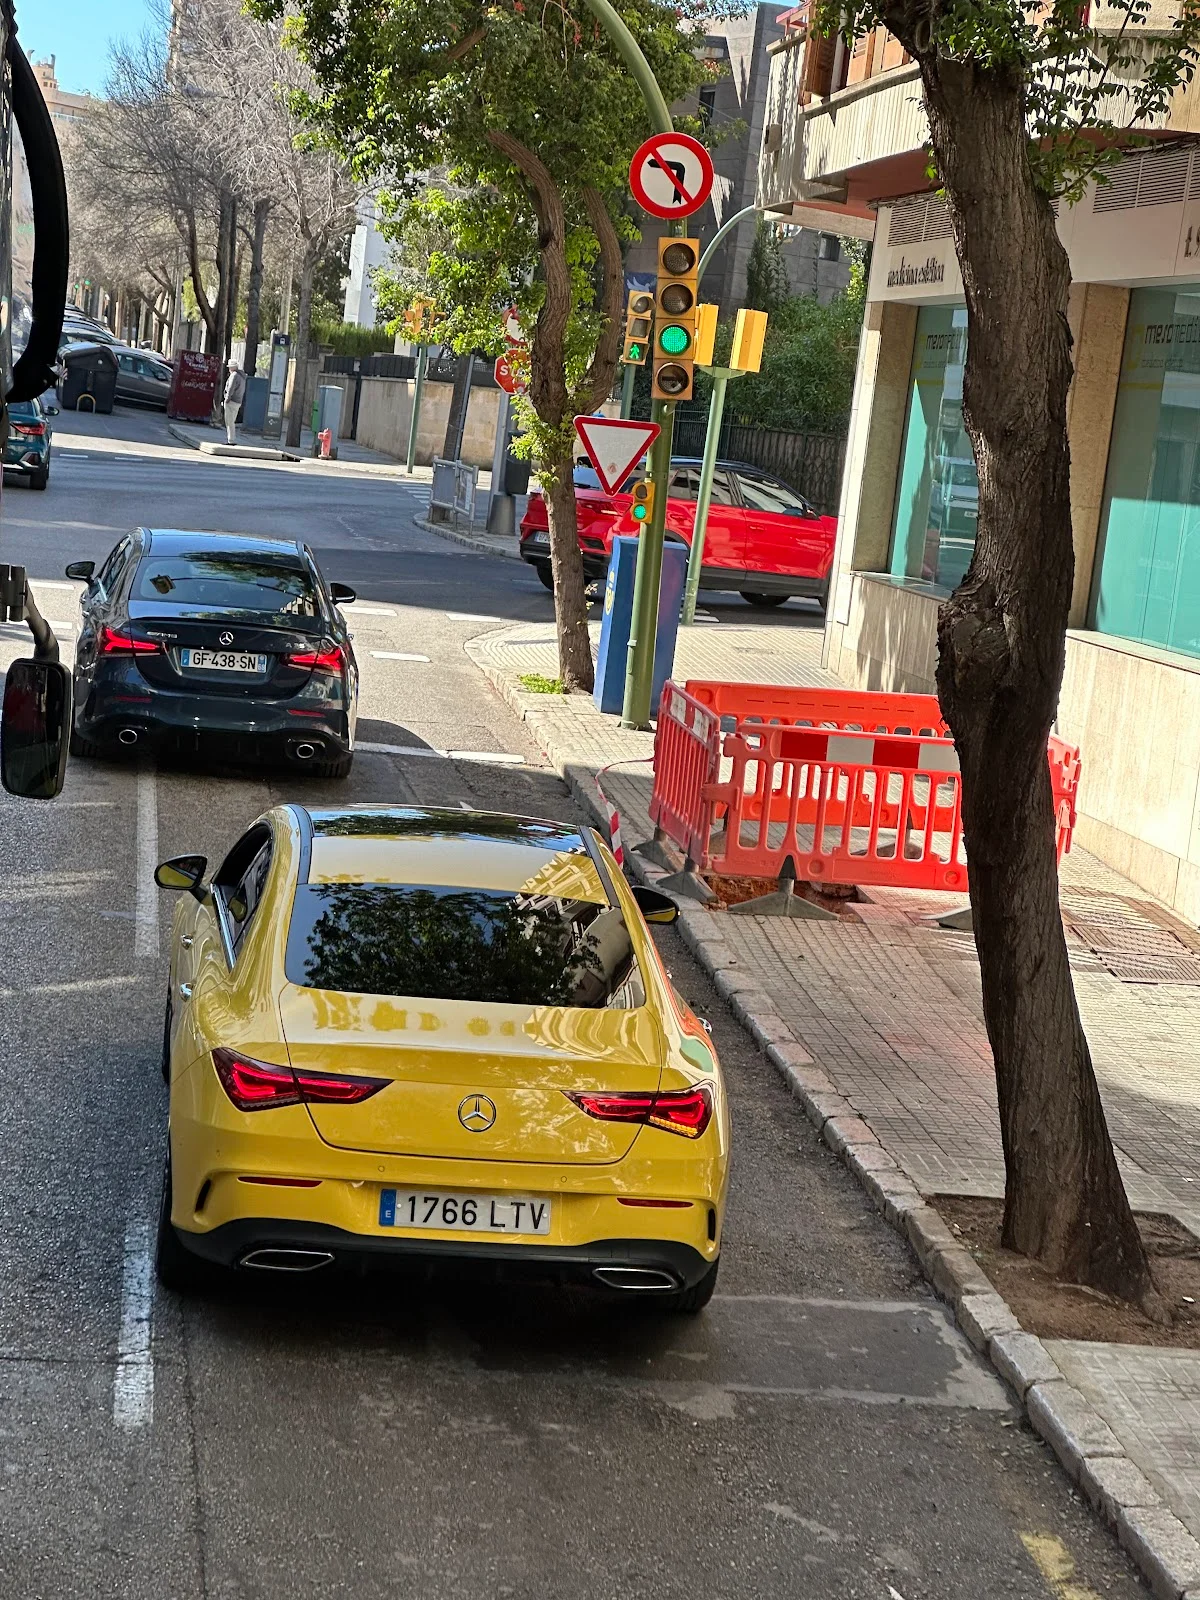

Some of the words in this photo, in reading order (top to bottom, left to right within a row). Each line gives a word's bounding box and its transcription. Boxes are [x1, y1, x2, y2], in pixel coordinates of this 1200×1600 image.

[193, 651, 256, 670] GF-438-SN
[385, 1210, 391, 1218] E
[408, 1195, 478, 1226] 1766
[490, 1200, 545, 1230] LTV
